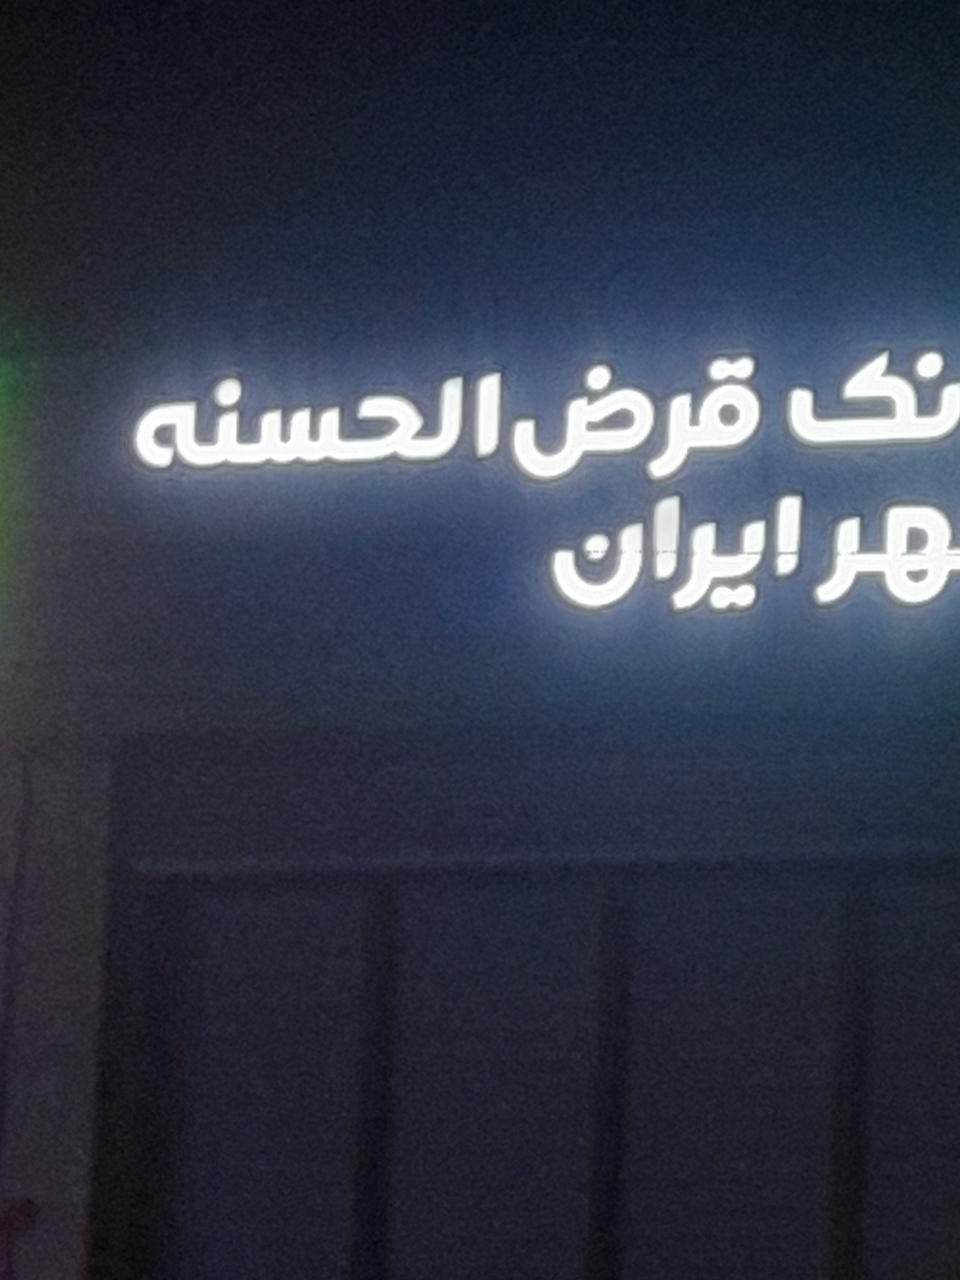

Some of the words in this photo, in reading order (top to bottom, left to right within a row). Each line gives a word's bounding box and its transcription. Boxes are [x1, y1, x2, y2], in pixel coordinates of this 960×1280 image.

[133, 372, 502, 468] الحسنه
[512, 356, 761, 479] قرض
[552, 494, 802, 610] ایران
